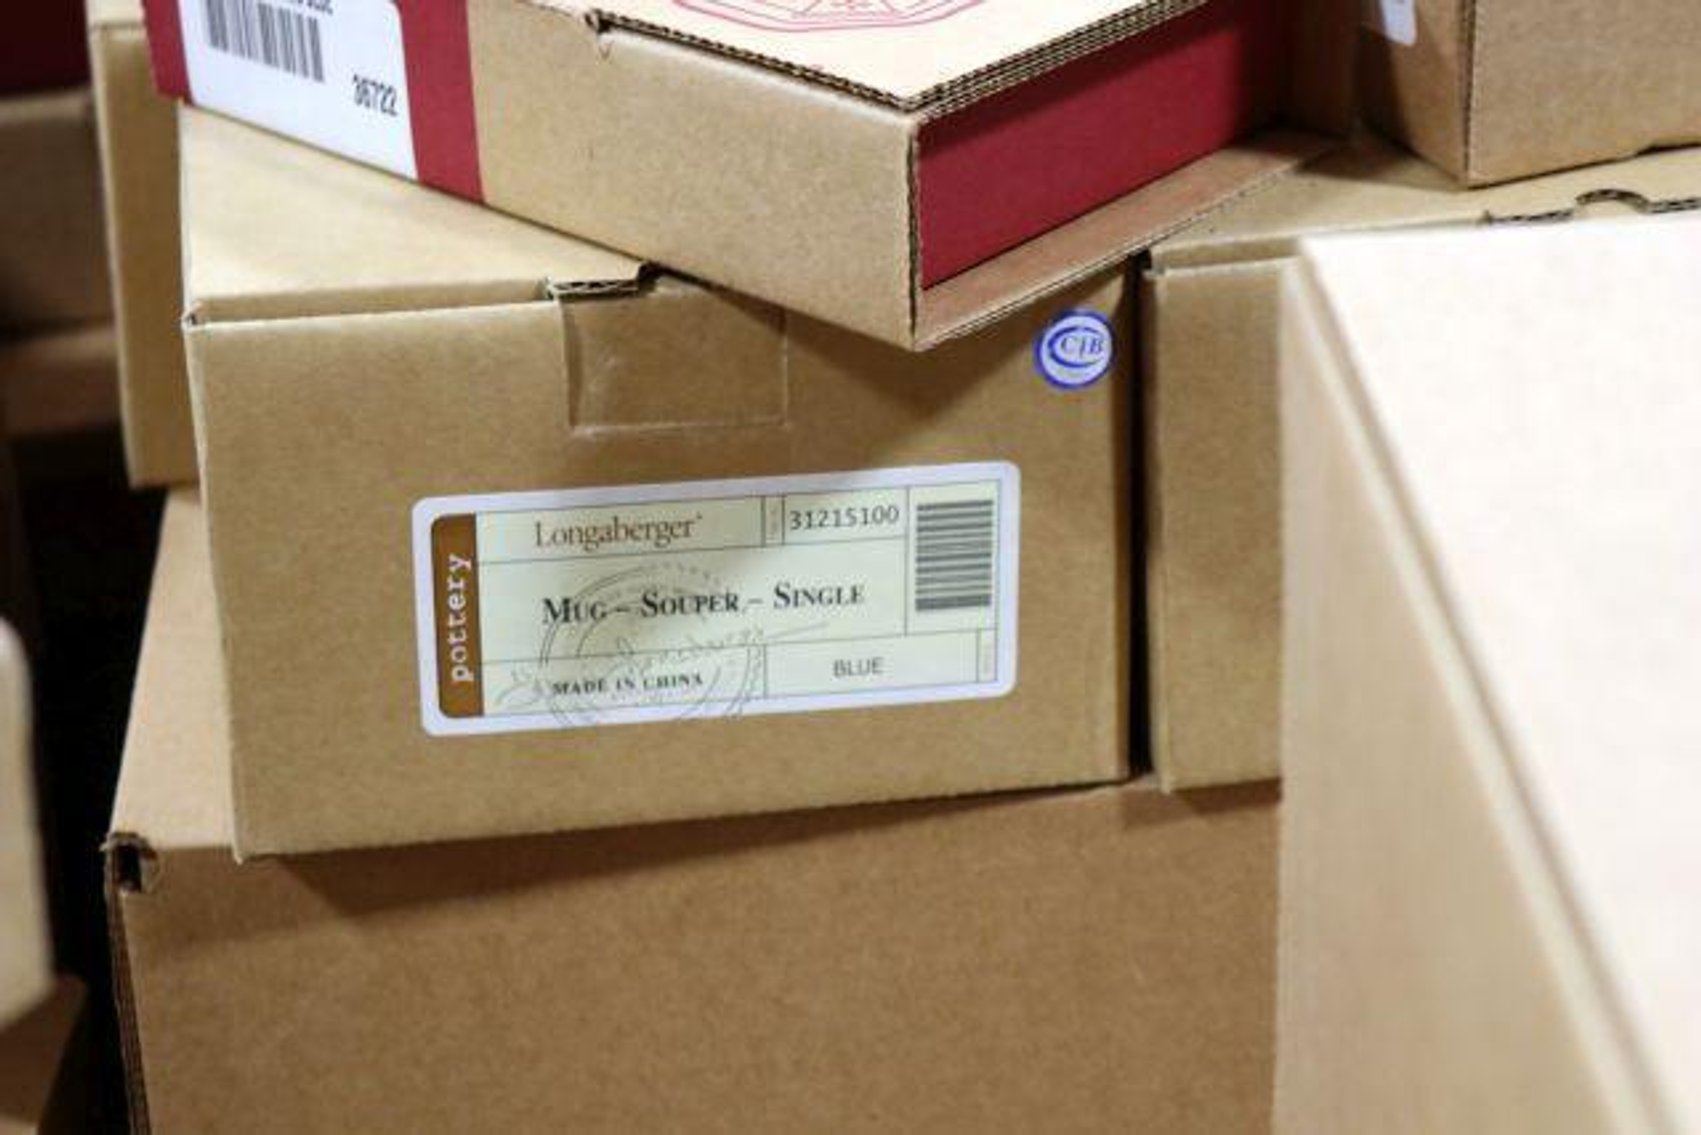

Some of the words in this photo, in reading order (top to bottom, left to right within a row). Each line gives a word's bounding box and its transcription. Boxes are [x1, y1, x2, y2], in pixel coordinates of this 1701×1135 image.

[790, 505, 900, 530] 31215100
[640, 586, 739, 618] SOUPER
[773, 582, 865, 609] SINGLE
[447, 553, 476, 683] pottery
[833, 657, 885, 677] BLUE
[553, 679, 606, 695] MADE
[617, 674, 636, 689] IN
[643, 673, 704, 690] CHINA
